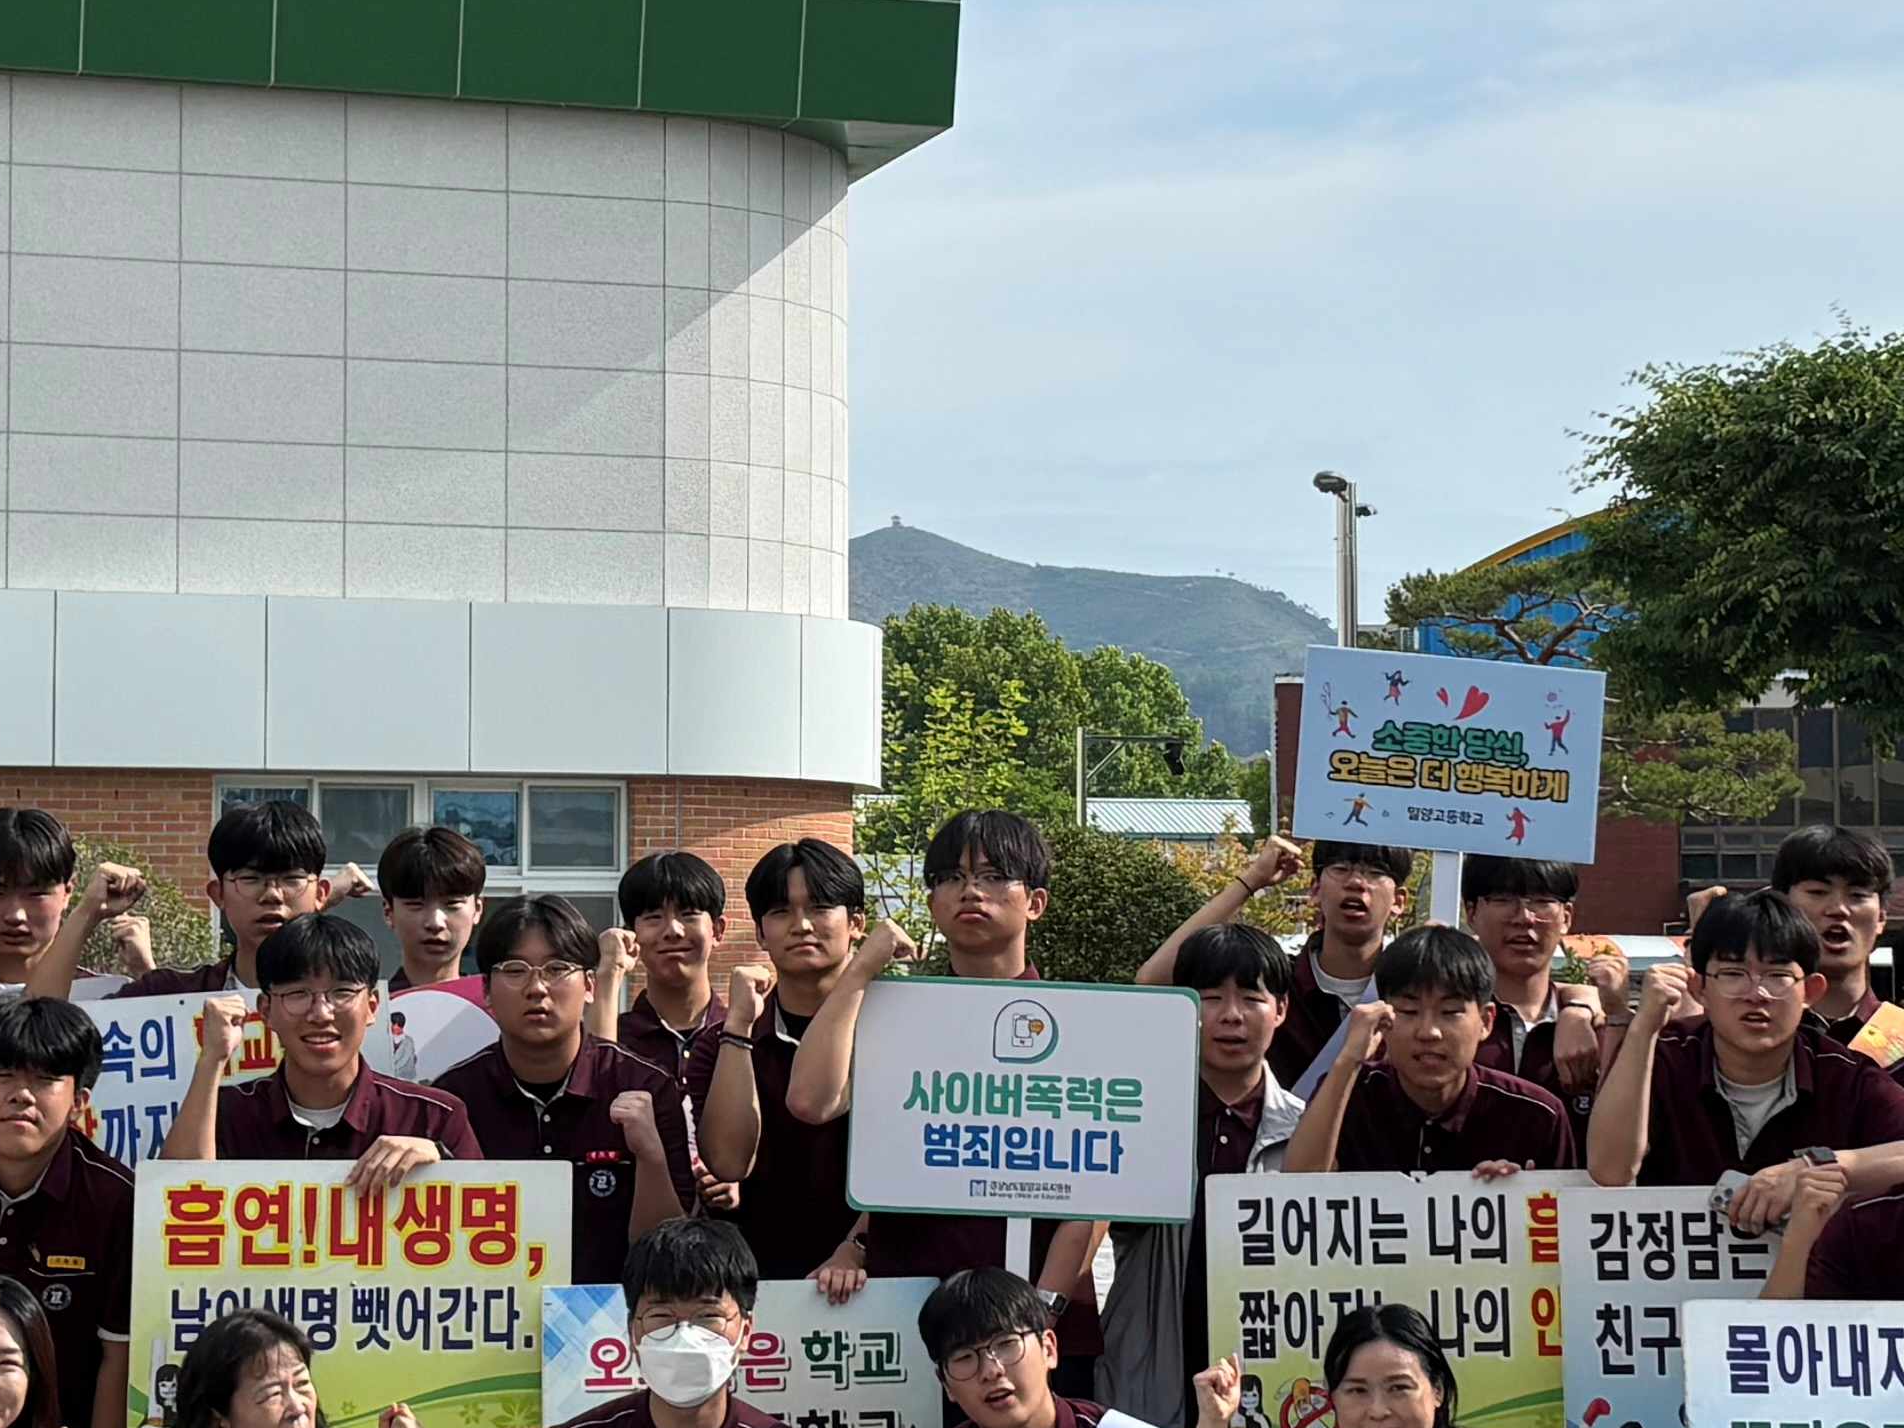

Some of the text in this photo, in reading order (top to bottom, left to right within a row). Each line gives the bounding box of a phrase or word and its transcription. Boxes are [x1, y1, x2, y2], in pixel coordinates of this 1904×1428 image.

[1372, 720, 1529, 765] 소중한 당신,
[1328, 750, 1570, 803] 오늘은 더 행복하게
[1407, 806, 1484, 826] 밀양고등학교
[903, 1070, 1144, 1123] 사이버폭력은
[924, 1123, 1124, 1174] 범죄입니다
[1238, 1196, 1408, 1267] 길어지는
[1428, 1193, 1508, 1265] 나의
[352, 1285, 535, 1352] 뺏어간다.
[1430, 1287, 1511, 1357] 나의
[801, 1330, 907, 1390] 학교
